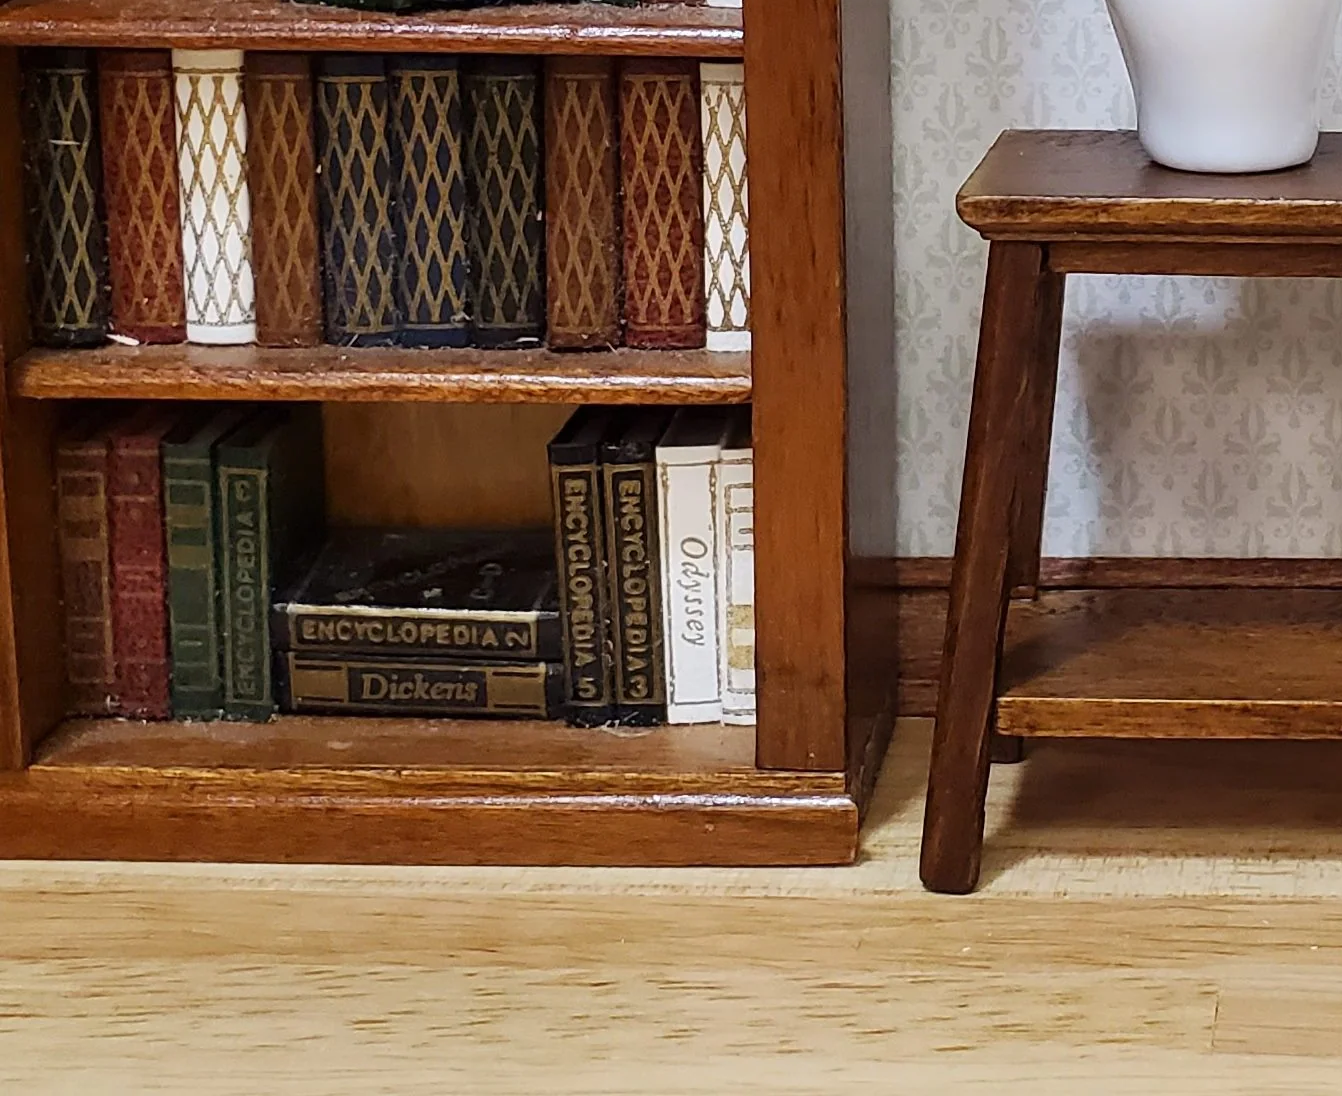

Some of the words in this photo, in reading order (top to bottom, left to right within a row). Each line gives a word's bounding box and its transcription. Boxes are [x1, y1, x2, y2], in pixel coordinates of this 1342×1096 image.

[236, 511, 256, 695] ENCYCLOPEDIA
[563, 478, 596, 668] ENCYCLOPEDIA
[618, 479, 650, 673] ENCYCLOPEDIA
[676, 537, 710, 647] Odyssey
[301, 618, 499, 648] ENCYCLOPEDIA
[504, 630, 530, 648] 2
[361, 673, 479, 702] Dickens
[578, 677, 599, 699] 5
[629, 675, 650, 697] 3
